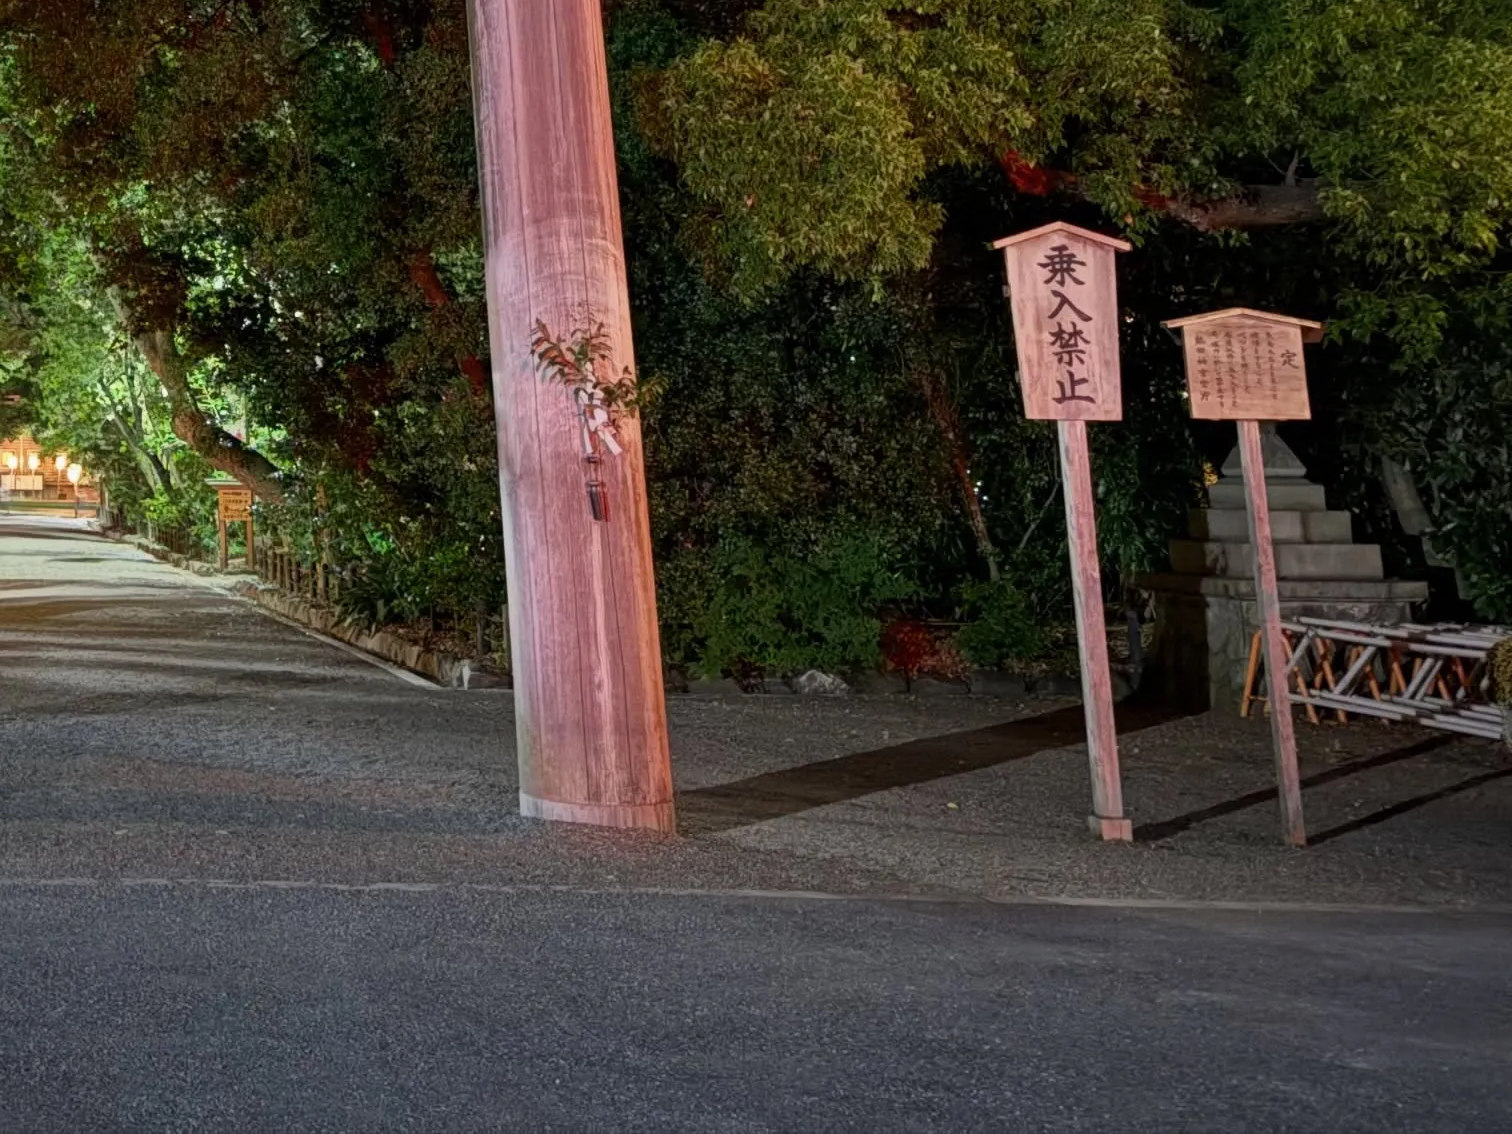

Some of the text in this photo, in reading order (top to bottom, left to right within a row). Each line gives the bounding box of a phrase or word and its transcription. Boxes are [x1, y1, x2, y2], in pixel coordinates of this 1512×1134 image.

[1037, 244, 1096, 405] 乗入禁止
[1280, 349, 1300, 370] 定
